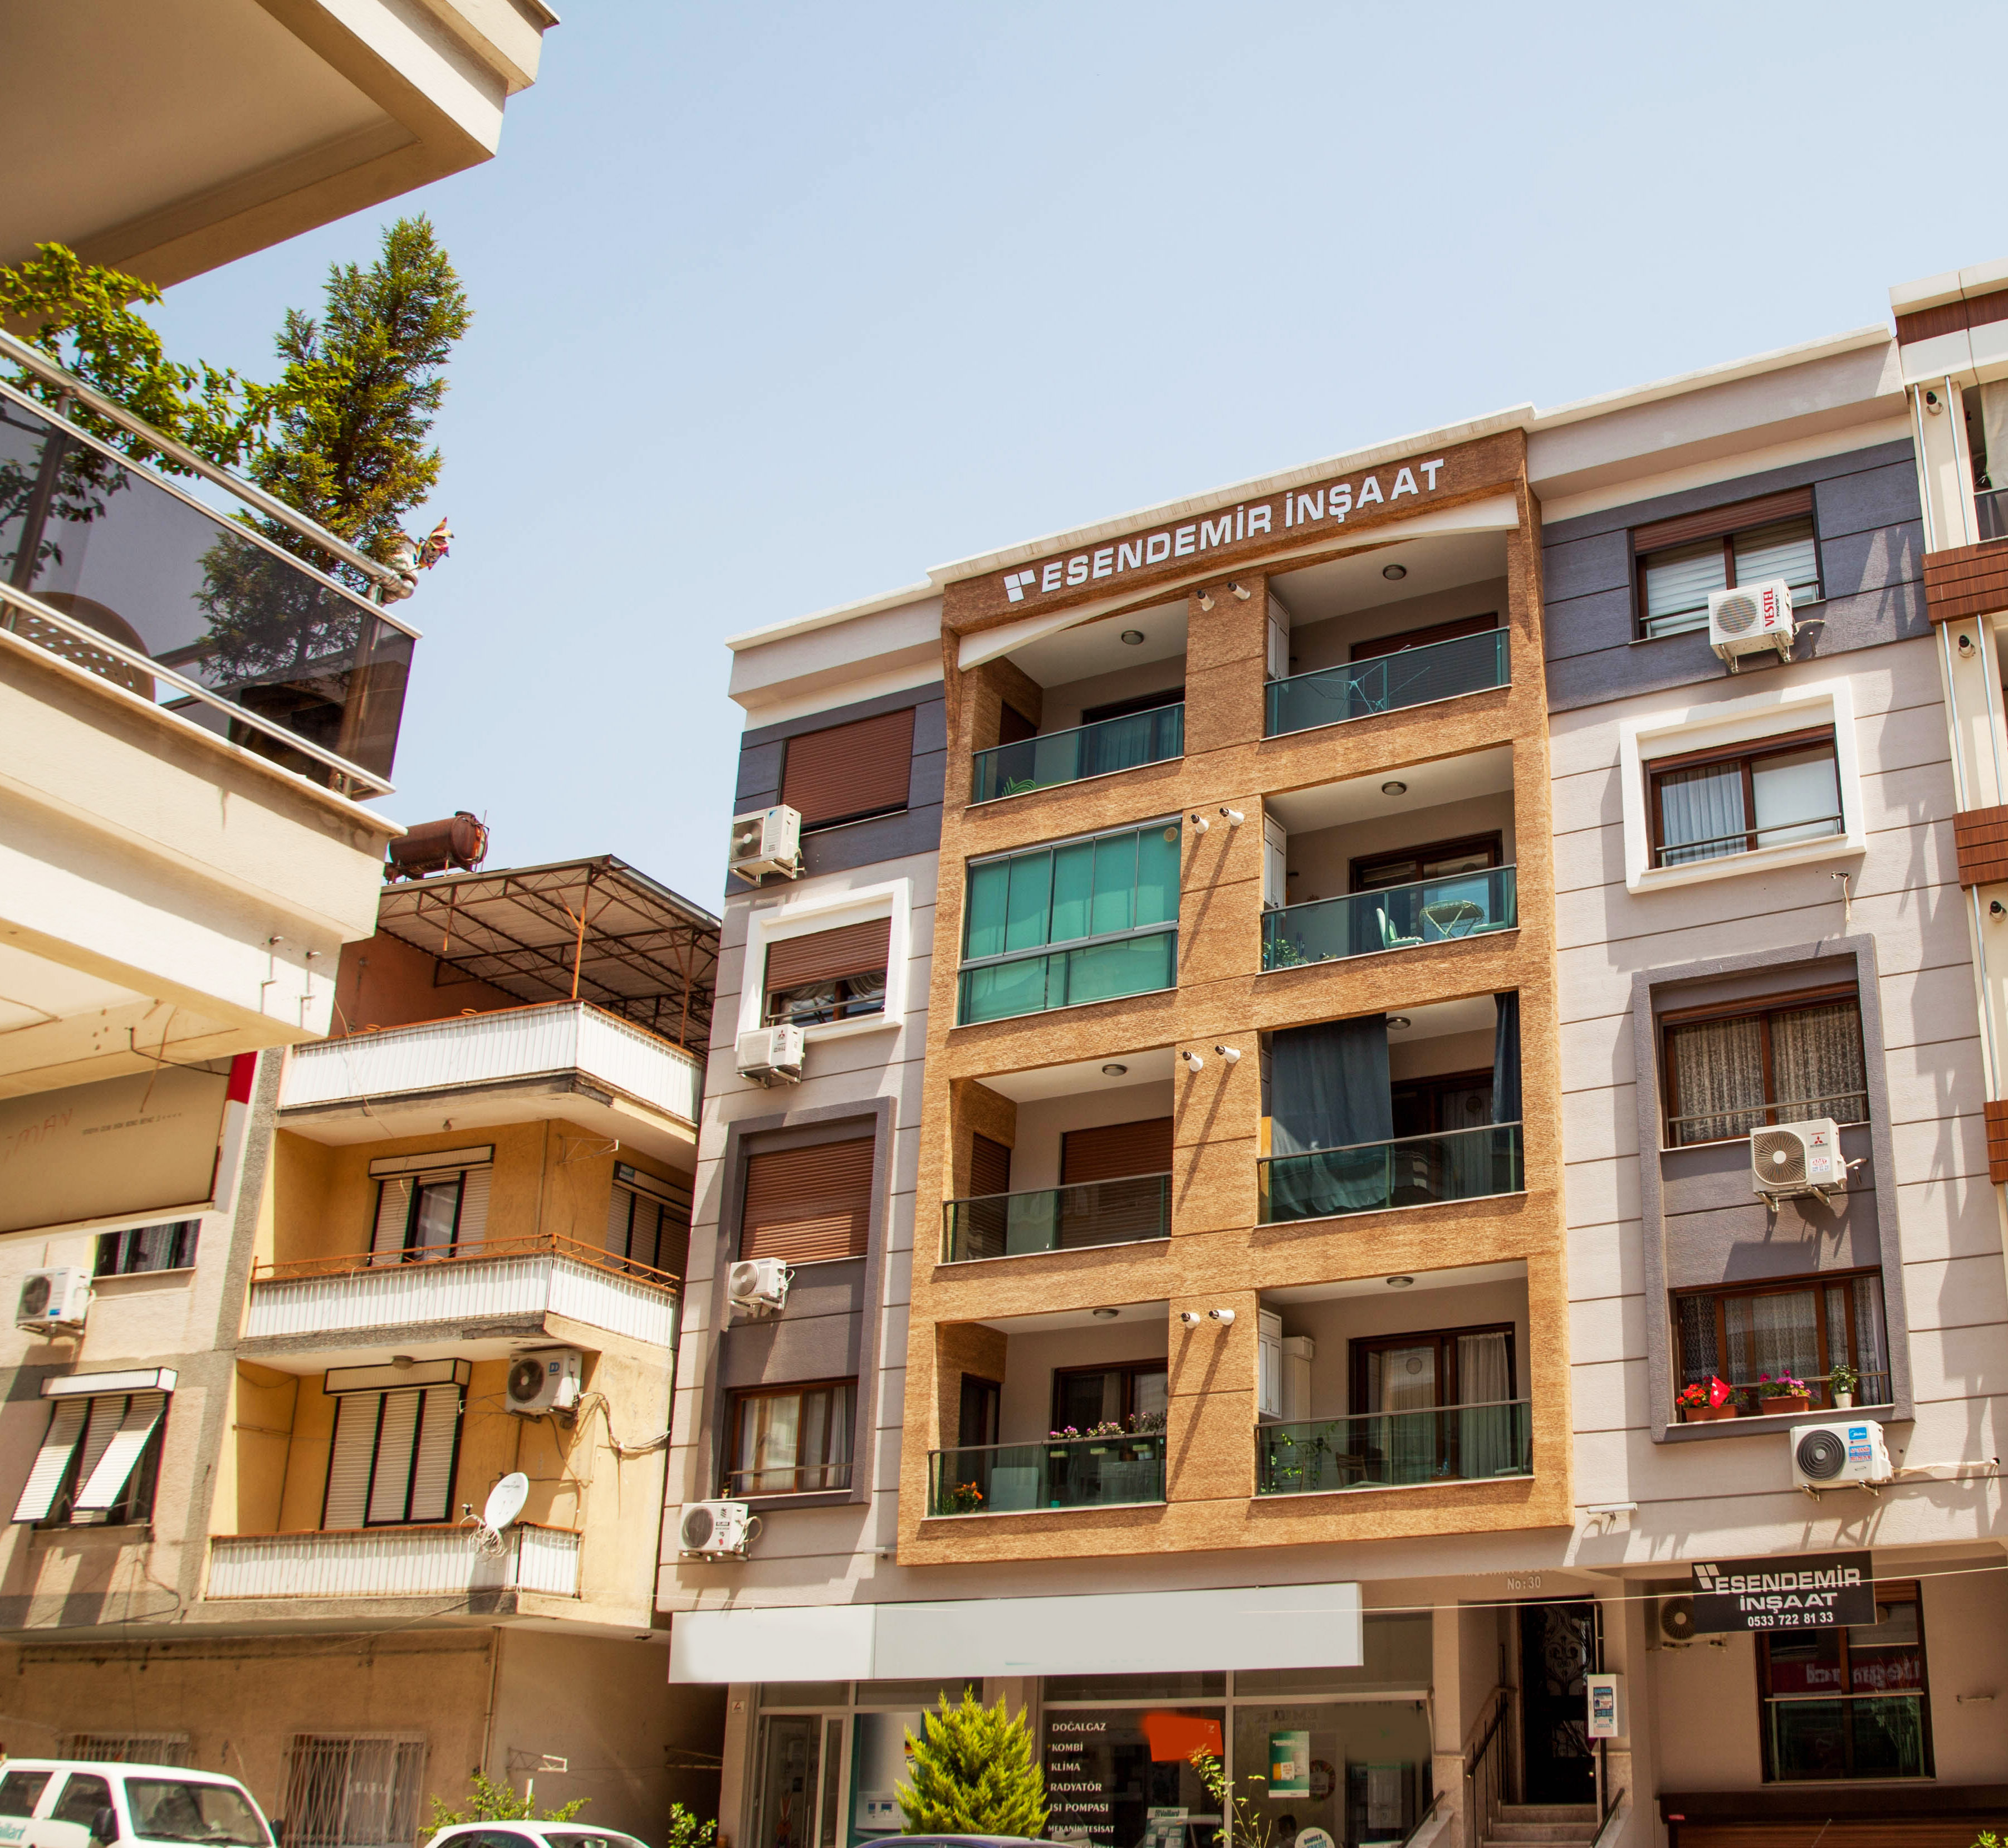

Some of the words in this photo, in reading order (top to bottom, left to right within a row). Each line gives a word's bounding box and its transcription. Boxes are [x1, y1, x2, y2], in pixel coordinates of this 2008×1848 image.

[1042, 505, 1272, 593] ESENDEMİR
[1285, 458, 1444, 527] İNŞAAT
[1764, 588, 1774, 627] VESTEL
[1715, 1565, 1861, 1595] ESENDEMİR
[1740, 1592, 1838, 1614] İNŞAAT
[1747, 1615, 1774, 1627] 0533
[1779, 1614, 1799, 1625] 722
[1804, 1613, 1816, 1624] 81
[1820, 1612, 1833, 1623] 33
[1052, 1721, 1106, 1732] DOĞALGAZ
[1052, 1742, 1084, 1752] KOMBİ
[1051, 1761, 1080, 1771] KLİMA
[1050, 1781, 1102, 1791] RADYATÖR
[1065, 1803, 1109, 1812] POMPASI
